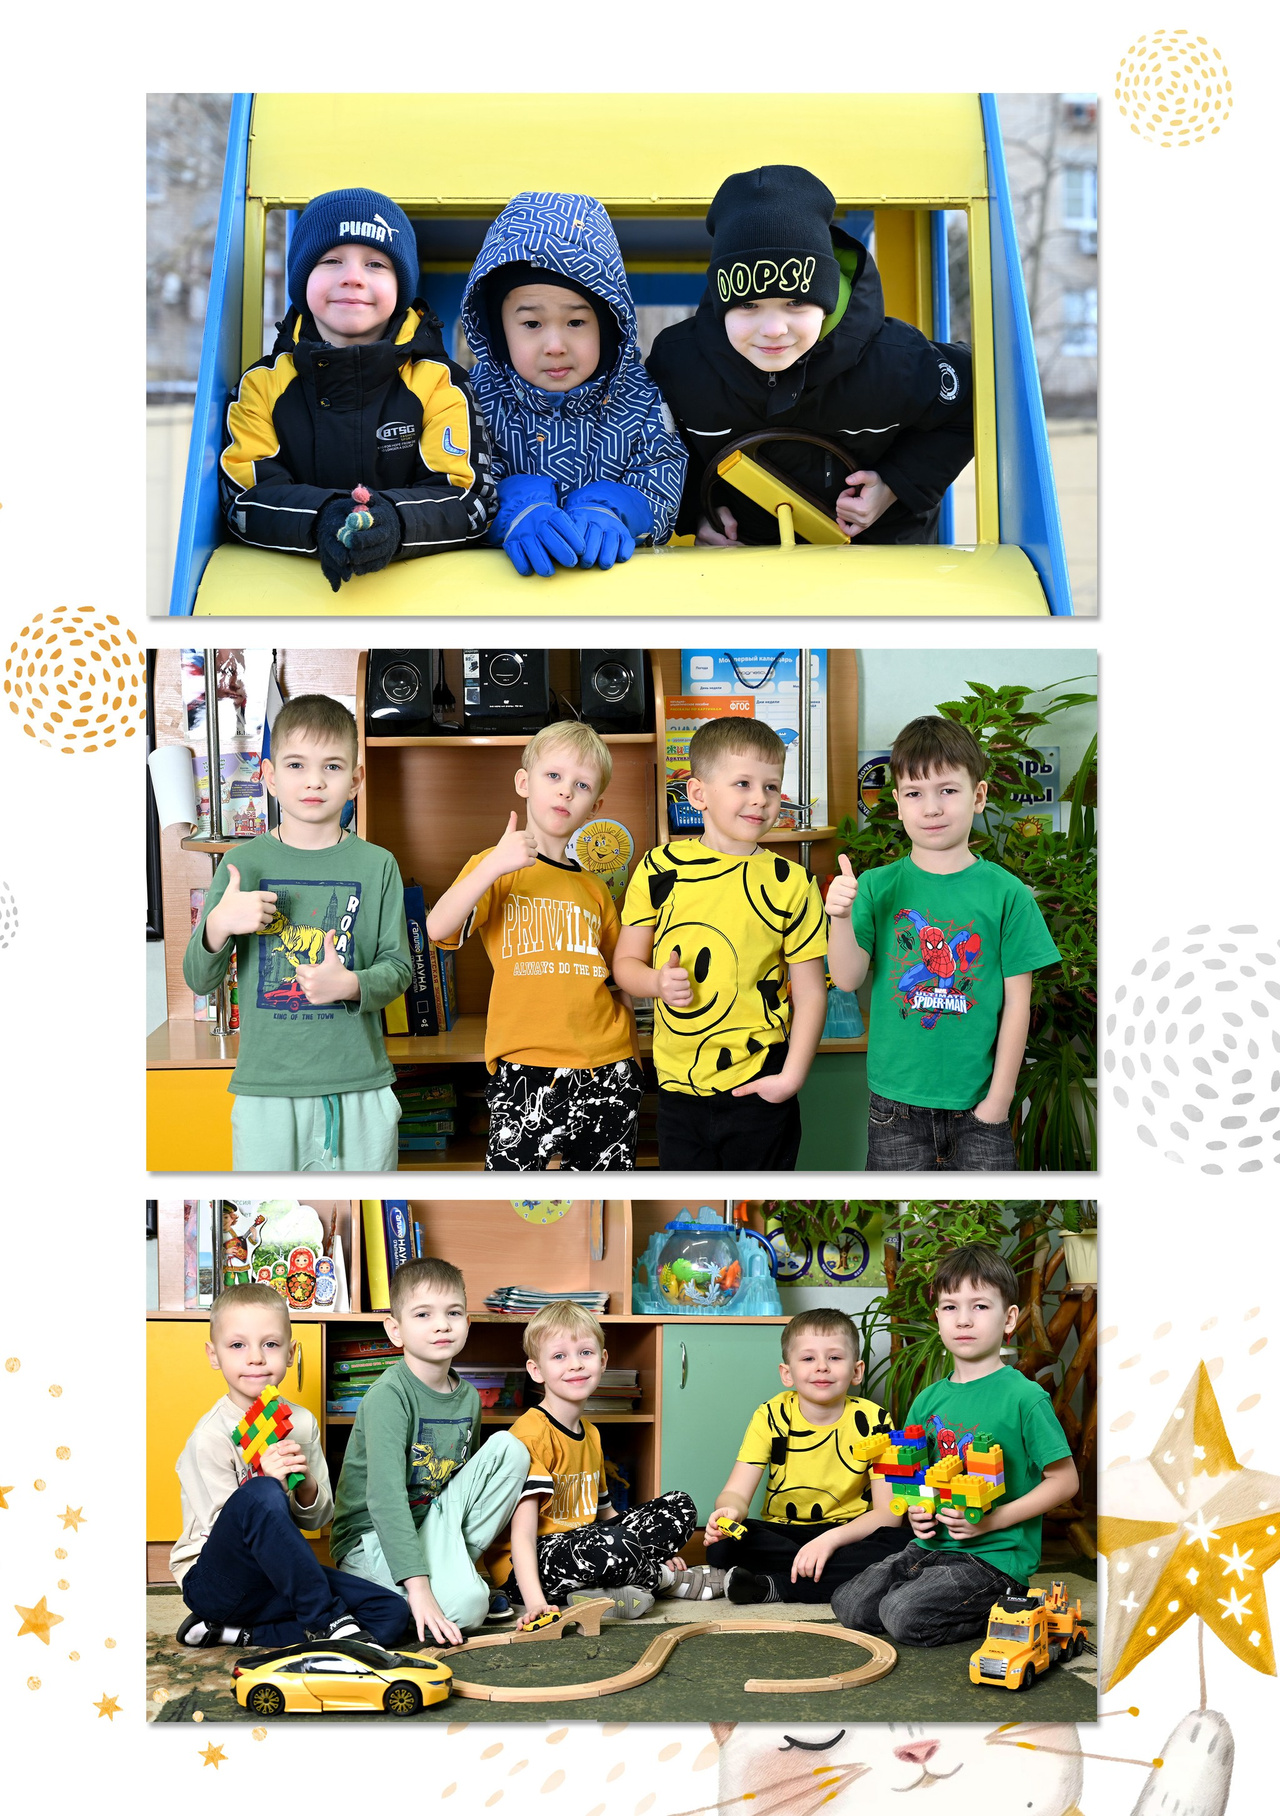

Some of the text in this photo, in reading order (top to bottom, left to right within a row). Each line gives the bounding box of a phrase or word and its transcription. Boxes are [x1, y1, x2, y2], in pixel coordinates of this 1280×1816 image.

[339, 221, 386, 242] PUMA
[717, 256, 816, 302] OOPS!
[383, 424, 416, 438] BTSG
[734, 655, 759, 663] первый
[759, 656, 793, 664] каледарь
[729, 702, 750, 711] ФГОС
[1019, 760, 1053, 777] арь
[1011, 788, 1052, 805] оды
[858, 799, 872, 816] ВЕЧЕ
[502, 893, 602, 960] PRIVILE
[416, 954, 427, 992] НАУКА
[429, 950, 439, 983] ДЕТСКАЯ
[513, 961, 608, 978] ALWAYS DO THE BES
[915, 990, 966, 999] ULTIMATE
[912, 995, 968, 1014] SPIDER-MAN
